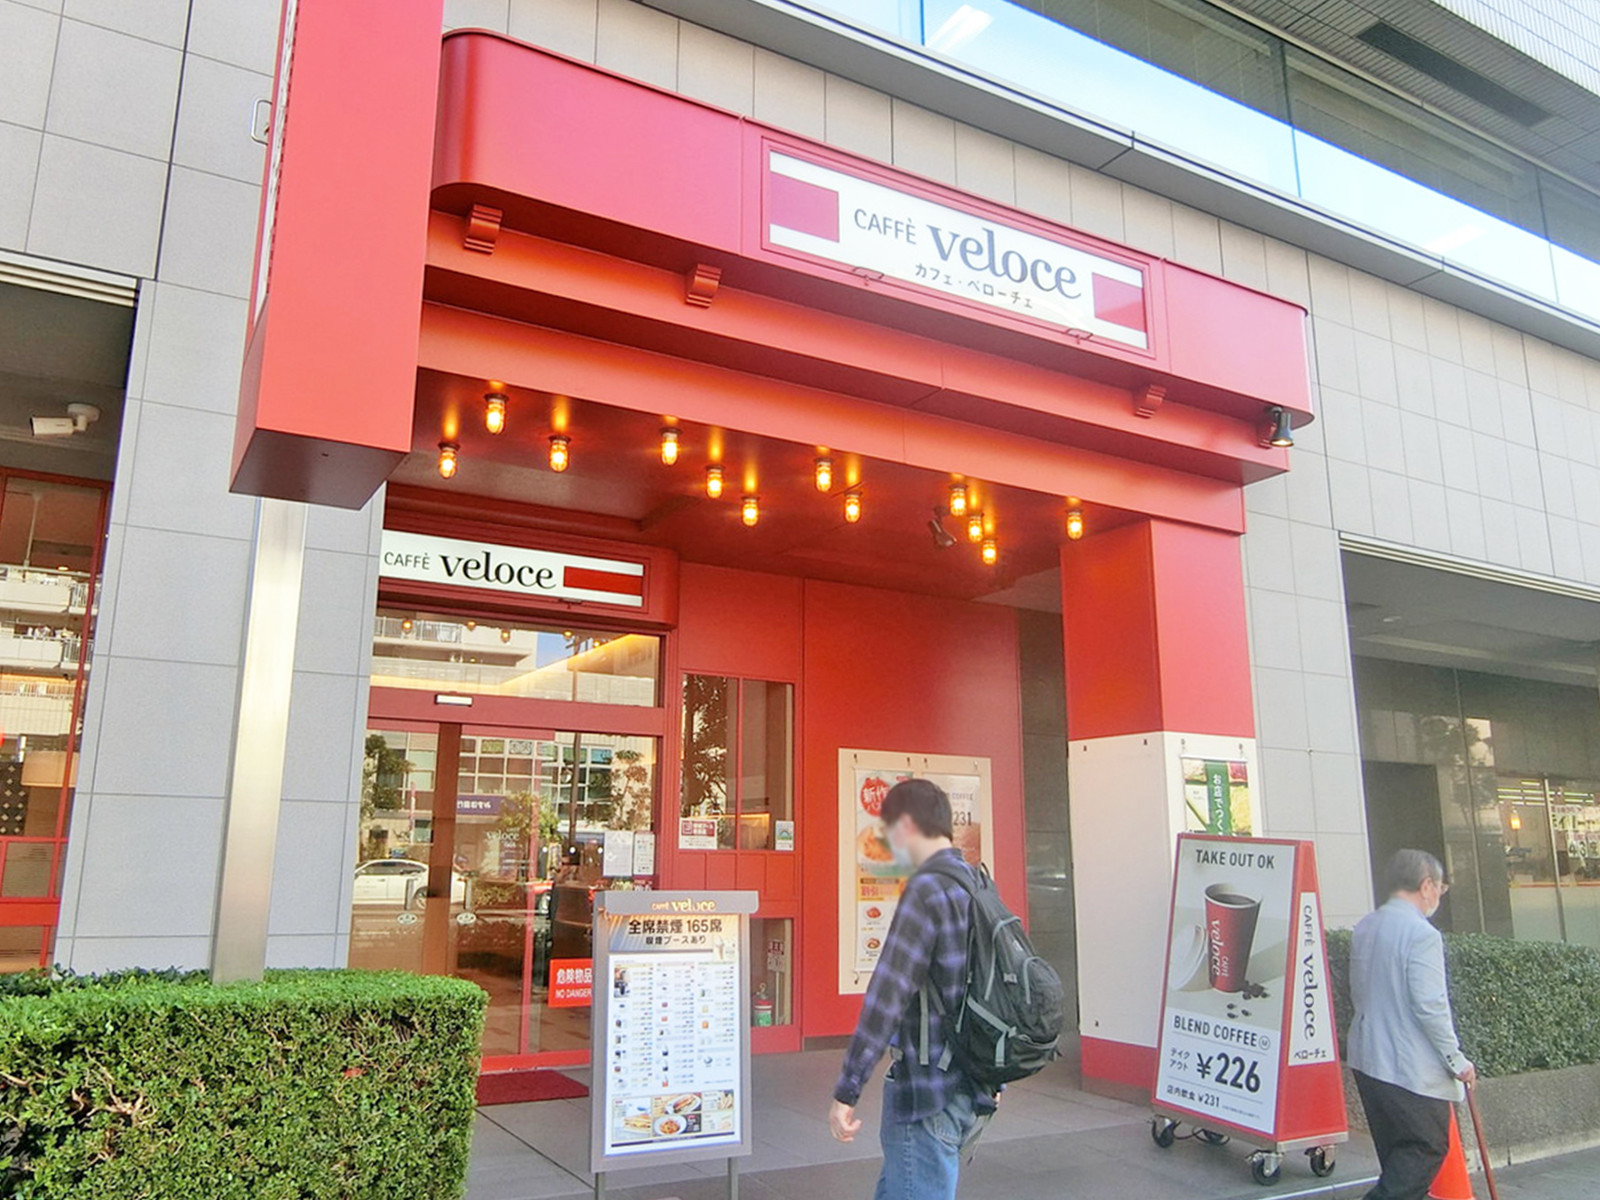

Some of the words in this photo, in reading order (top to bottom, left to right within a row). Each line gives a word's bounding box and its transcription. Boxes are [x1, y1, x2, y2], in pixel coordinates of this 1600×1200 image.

[853, 208, 917, 246] CAFFÈ
[926, 224, 1082, 299] veloce
[384, 551, 430, 570] CAFFÈ
[439, 550, 557, 590] veloce
[1196, 849, 1226, 866] TAKE
[1229, 852, 1254, 868] OUT
[1257, 854, 1275, 869] OK
[1211, 920, 1225, 977] veloce
[1303, 953, 1318, 1041] veloce
[1174, 1015, 1210, 1036] BLEND
[1213, 1024, 1258, 1048] COFFEE
[1196, 1052, 1261, 1094] ¥226
[1197, 1092, 1220, 1108] ¥231
